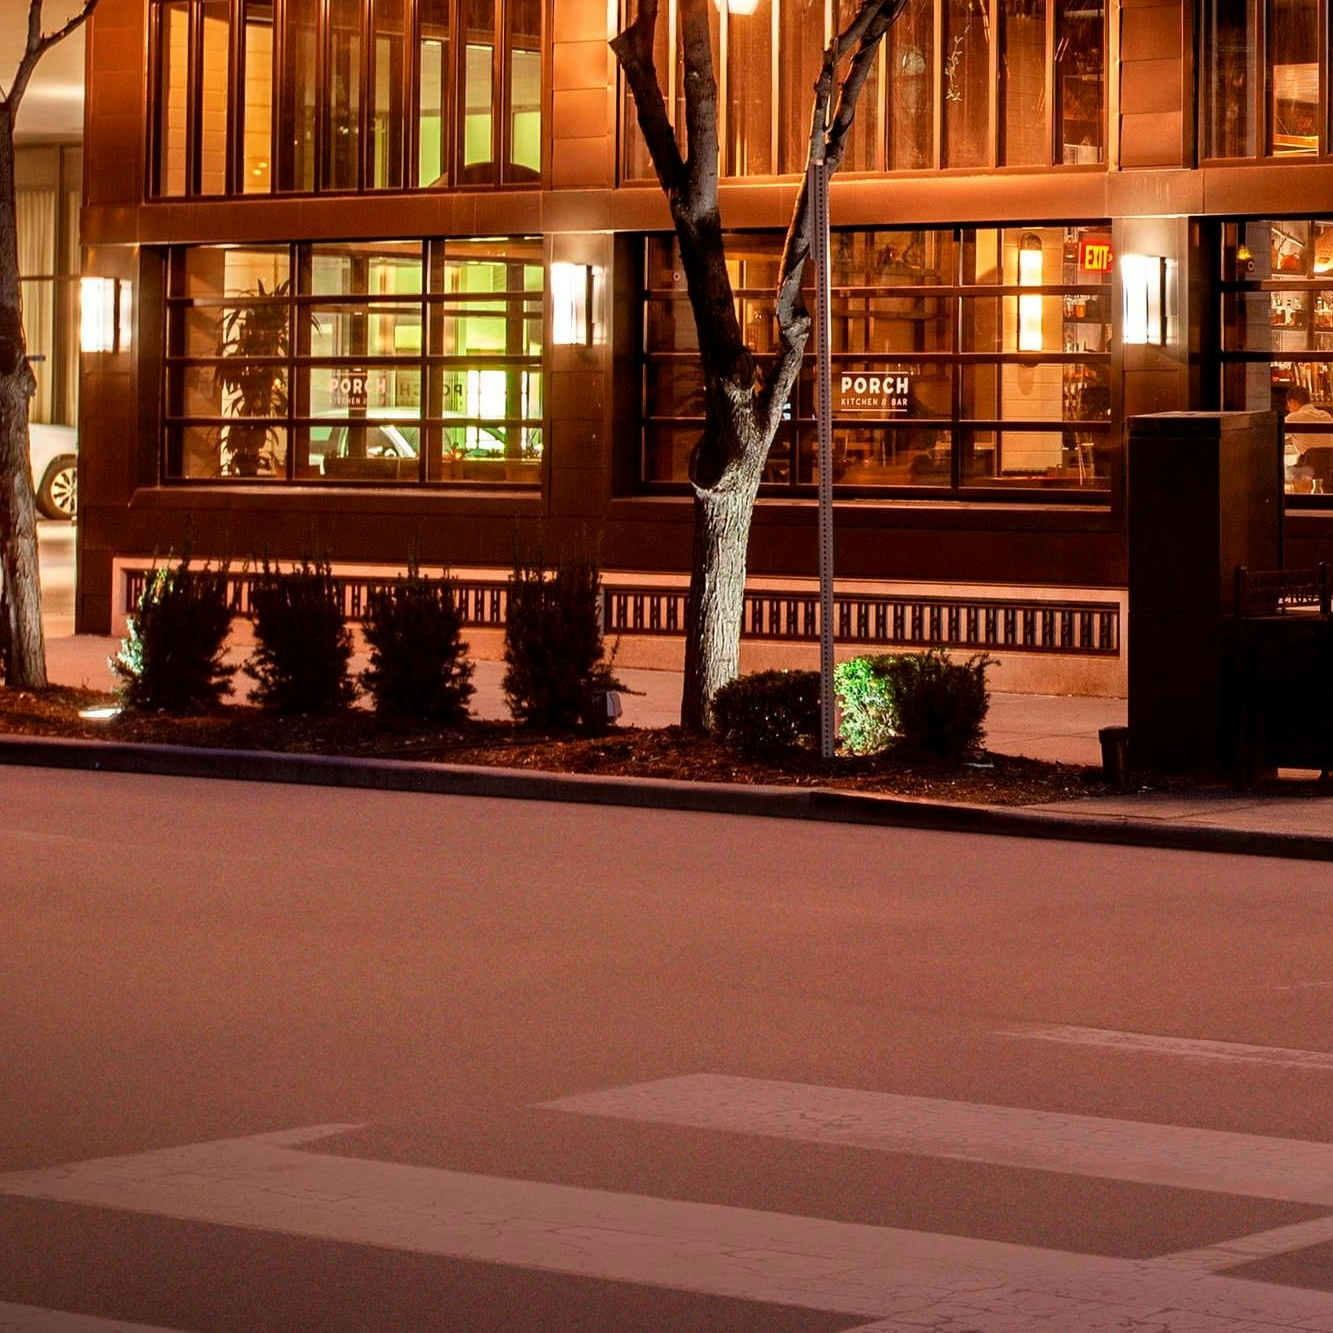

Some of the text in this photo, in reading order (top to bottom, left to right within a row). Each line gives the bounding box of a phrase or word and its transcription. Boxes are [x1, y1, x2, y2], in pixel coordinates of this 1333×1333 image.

[1085, 245, 1110, 270] EXIT
[329, 377, 387, 395] PORCH
[841, 377, 909, 395] PORCH
[841, 398, 879, 407] KITCHEN
[891, 398, 908, 407] BAR
